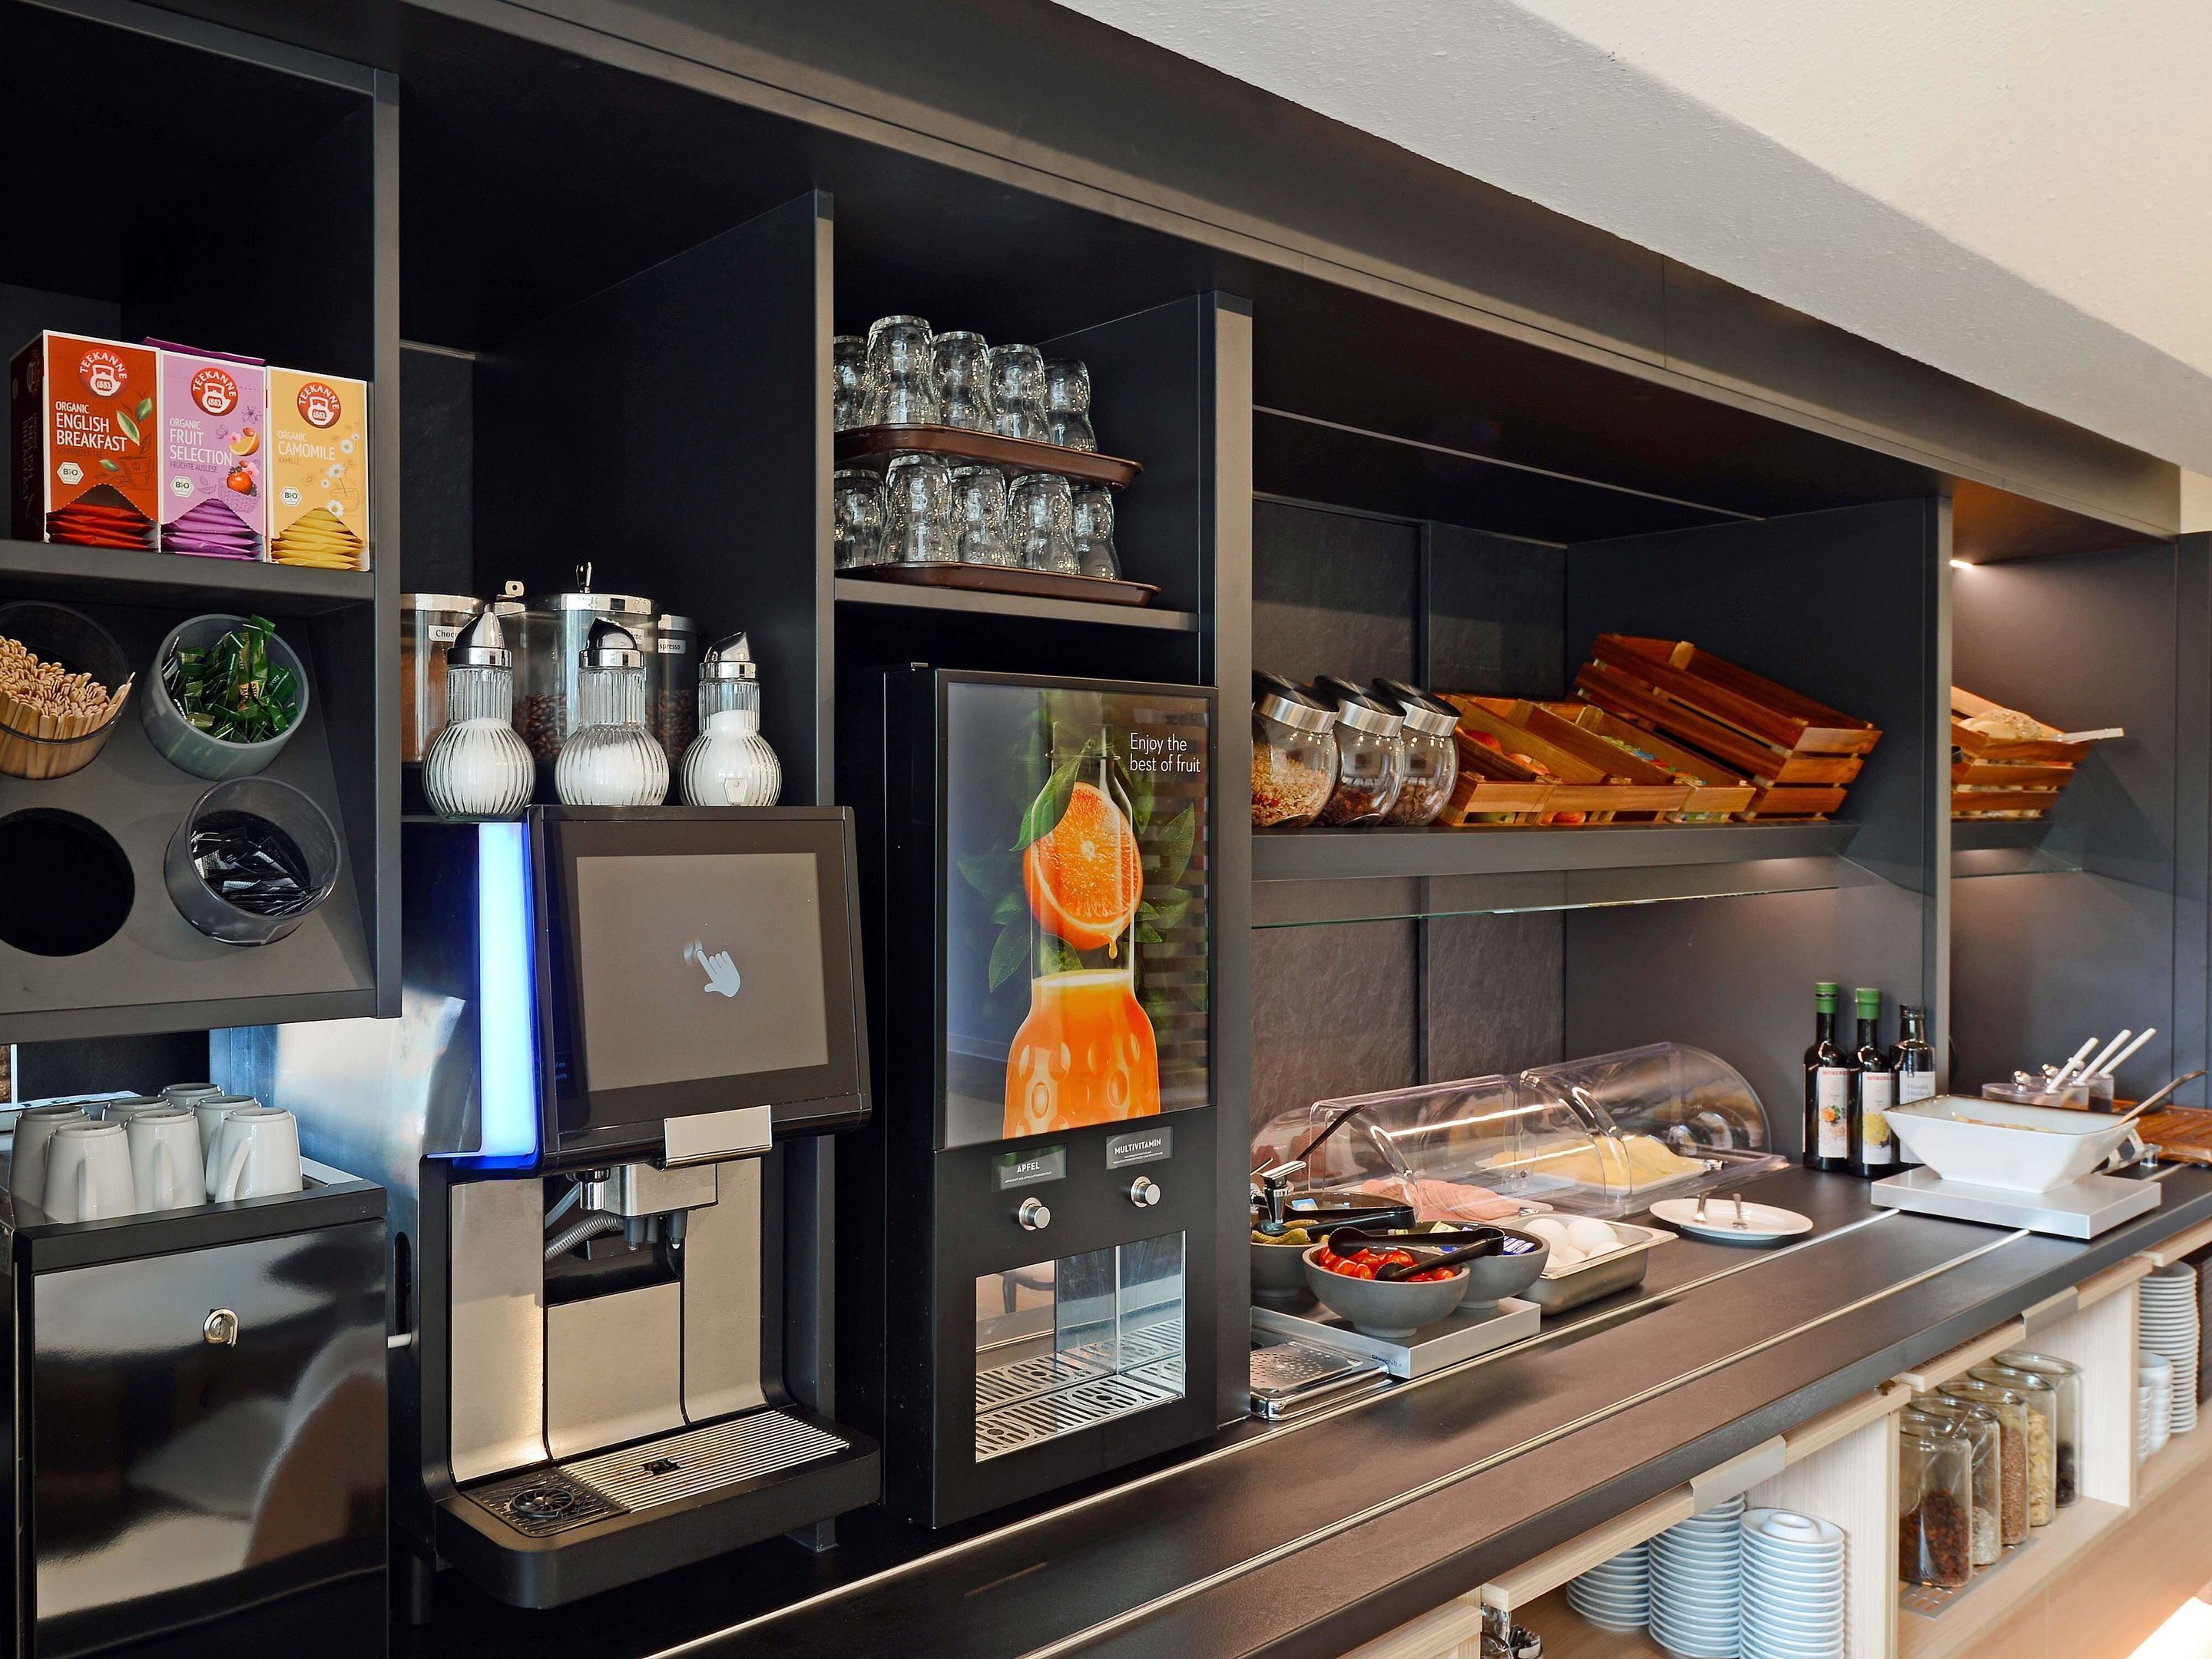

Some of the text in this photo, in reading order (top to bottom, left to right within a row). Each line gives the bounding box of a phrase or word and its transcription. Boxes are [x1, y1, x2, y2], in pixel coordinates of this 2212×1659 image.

[79, 351, 128, 380] TEEKANNE
[192, 370, 237, 397] TEEKANNE
[55, 400, 90, 414] ORGANIC
[298, 385, 340, 410] TEEKANNE
[56, 412, 109, 433] ENGLISH
[169, 417, 201, 430] ORGANIC
[56, 429, 127, 452] BREAKFAST
[170, 429, 204, 446] FRUIT
[277, 430, 307, 442] ORGANIC
[170, 445, 233, 466] SELECTION
[278, 441, 336, 461] CAMOMILE
[170, 460, 218, 473] FRÜCHTE AUSLESE
[1130, 732, 1187, 757] Enjoy the
[1130, 753, 1201, 773] best of fruit
[1114, 1137, 1162, 1155] MULTIVITAMIN
[1016, 1161, 1041, 1174] APFEL
